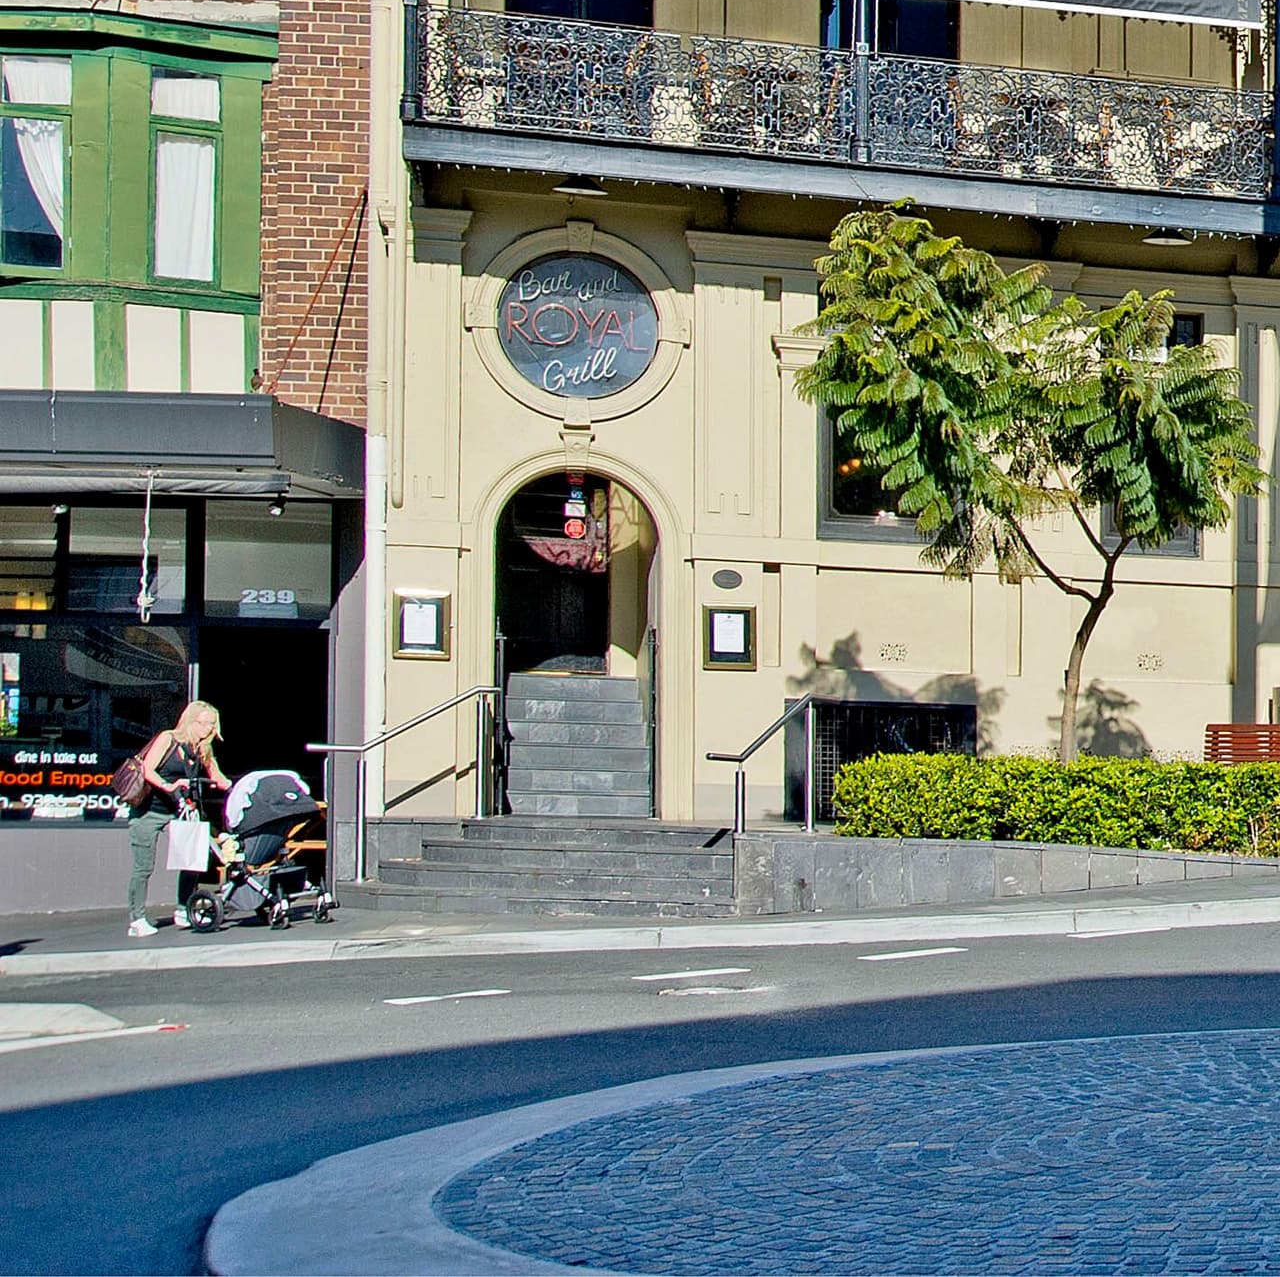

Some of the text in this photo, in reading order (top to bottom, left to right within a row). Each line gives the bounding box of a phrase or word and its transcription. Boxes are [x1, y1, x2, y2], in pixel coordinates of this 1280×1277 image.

[519, 270, 621, 301] Bar and
[506, 302, 649, 351] ROYAL
[543, 347, 617, 391] Grill
[240, 589, 296, 604] 239
[14, 750, 98, 764] dine in take out
[50, 770, 114, 789] Empor
